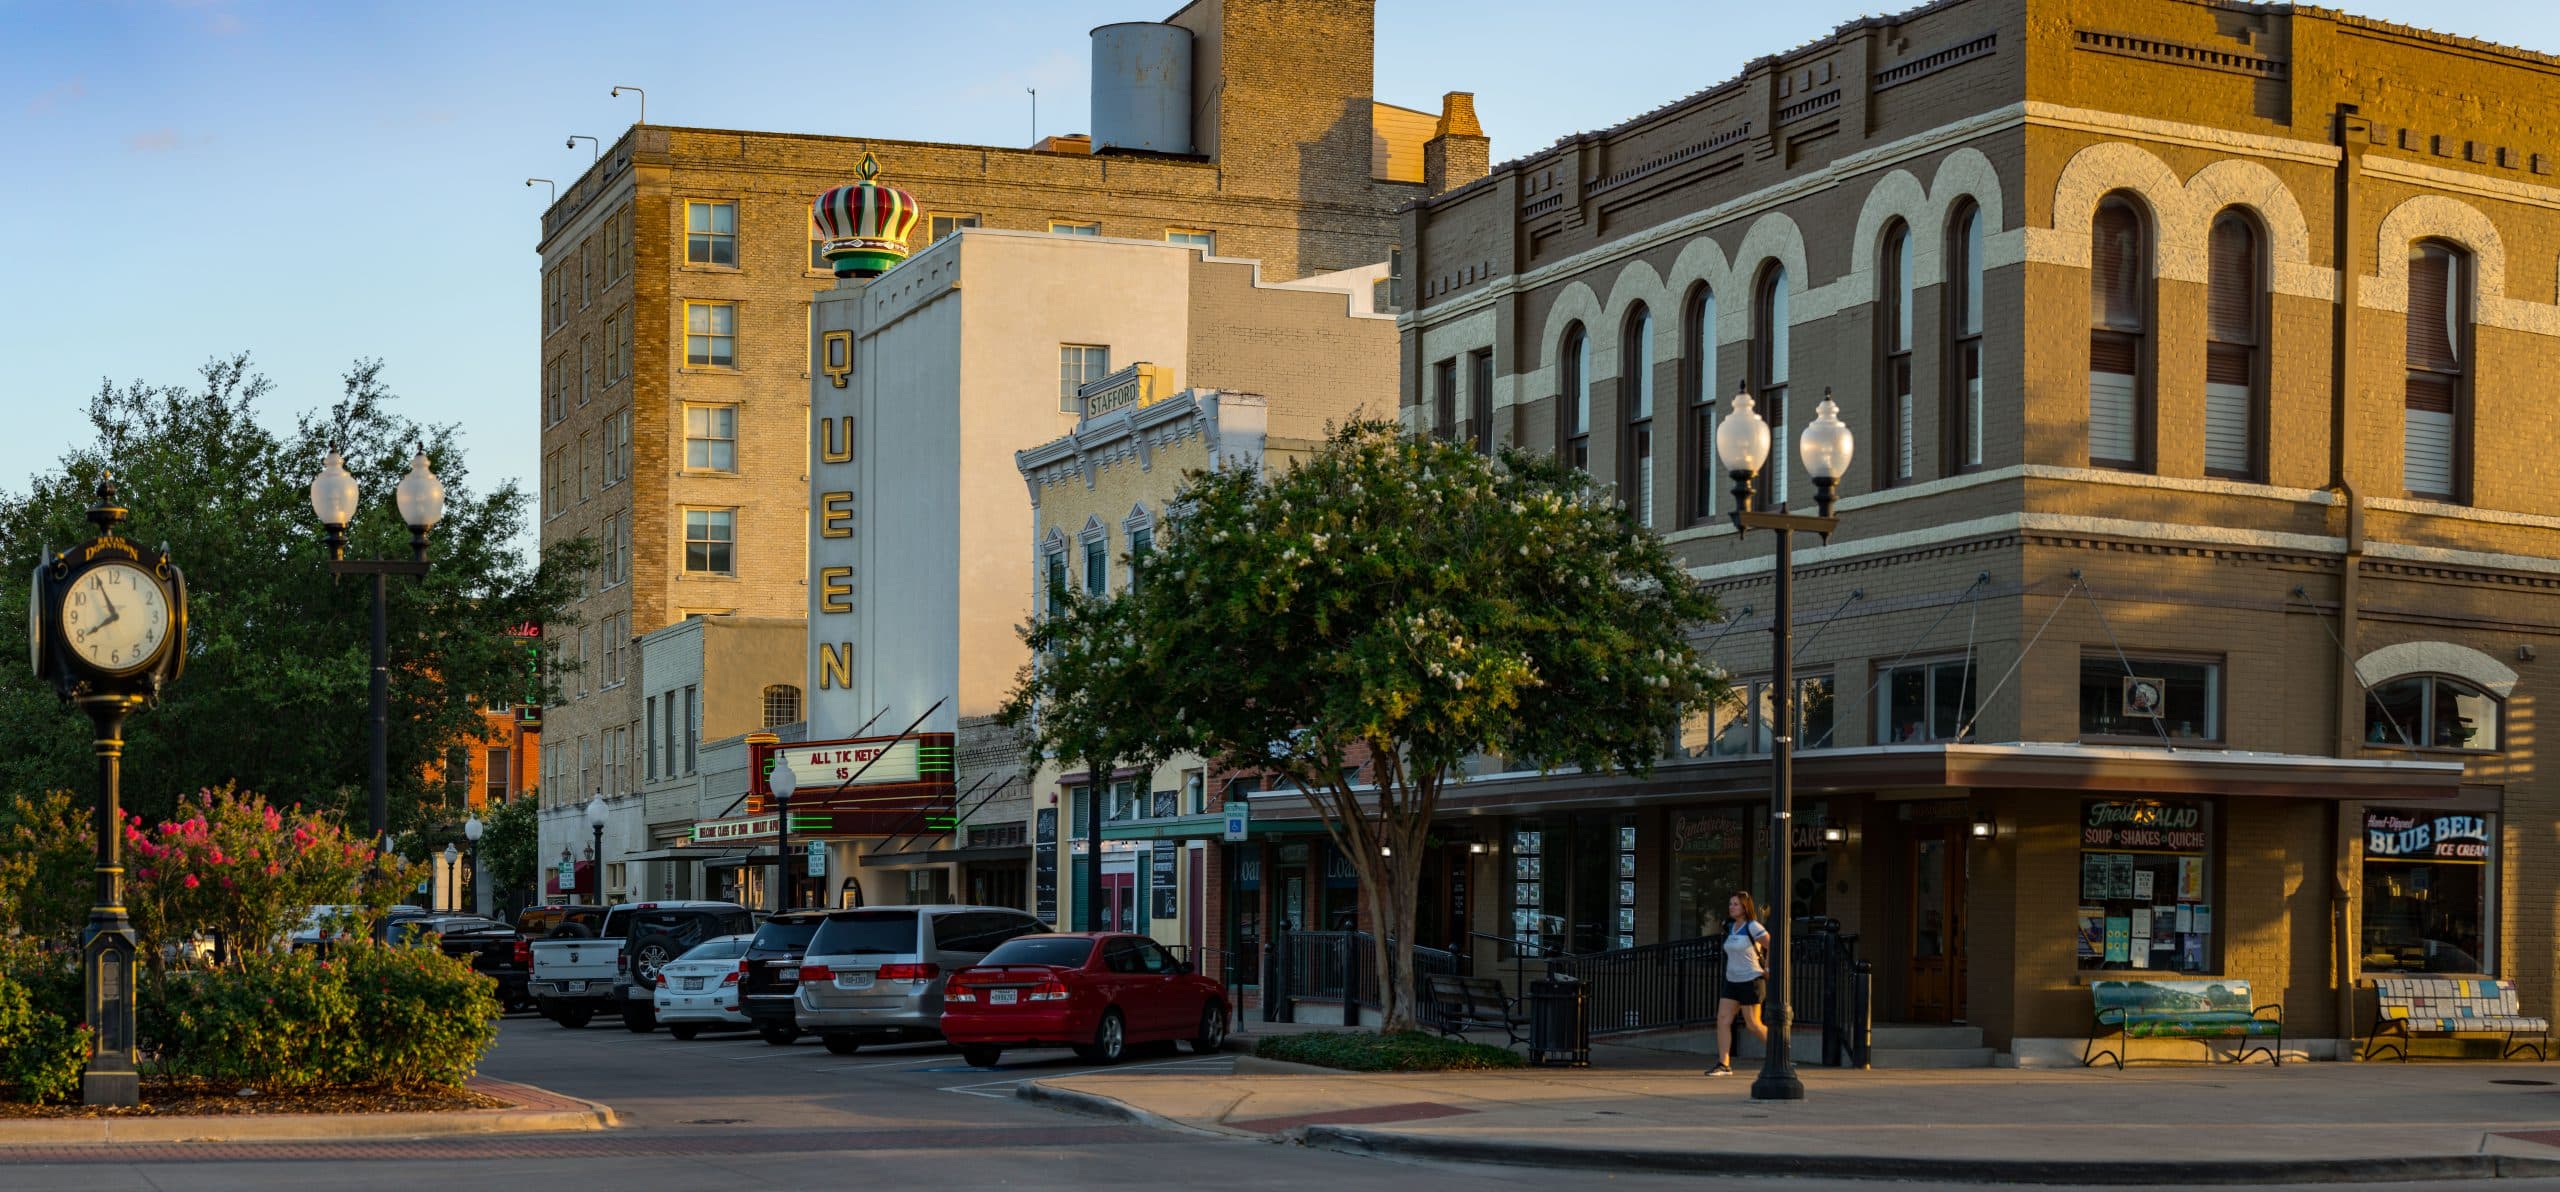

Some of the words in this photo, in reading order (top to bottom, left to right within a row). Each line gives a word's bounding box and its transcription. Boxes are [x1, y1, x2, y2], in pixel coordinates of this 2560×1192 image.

[1091, 384, 1136, 415] STAFFORD
[820, 329, 854, 691] QUEEN
[97, 536, 126, 544] BRYAN
[85, 541, 139, 561] DOWNTOWN
[109, 571, 120, 584] 12
[132, 577, 137, 590] 1
[74, 592, 86, 606] 10
[146, 592, 153, 605] 2
[70, 610, 78, 624] 9
[152, 611, 159, 624] 3
[76, 629, 85, 643] 8
[146, 629, 154, 643] 4
[90, 645, 98, 658] 7
[112, 650, 119, 664] 6
[132, 644, 141, 658] 5
[811, 750, 830, 765] ALL
[836, 768, 848, 780] $5
[2143, 807, 2198, 828] SALAD
[2085, 828, 2113, 844] SOUP
[2120, 830, 2161, 846] SHAKES
[2168, 832, 2206, 850] QUICHE
[2369, 824, 2430, 854] BLUE
[2434, 816, 2488, 842] BELL
[2435, 843, 2455, 855] ICE
[2456, 844, 2489, 856] CREAM
